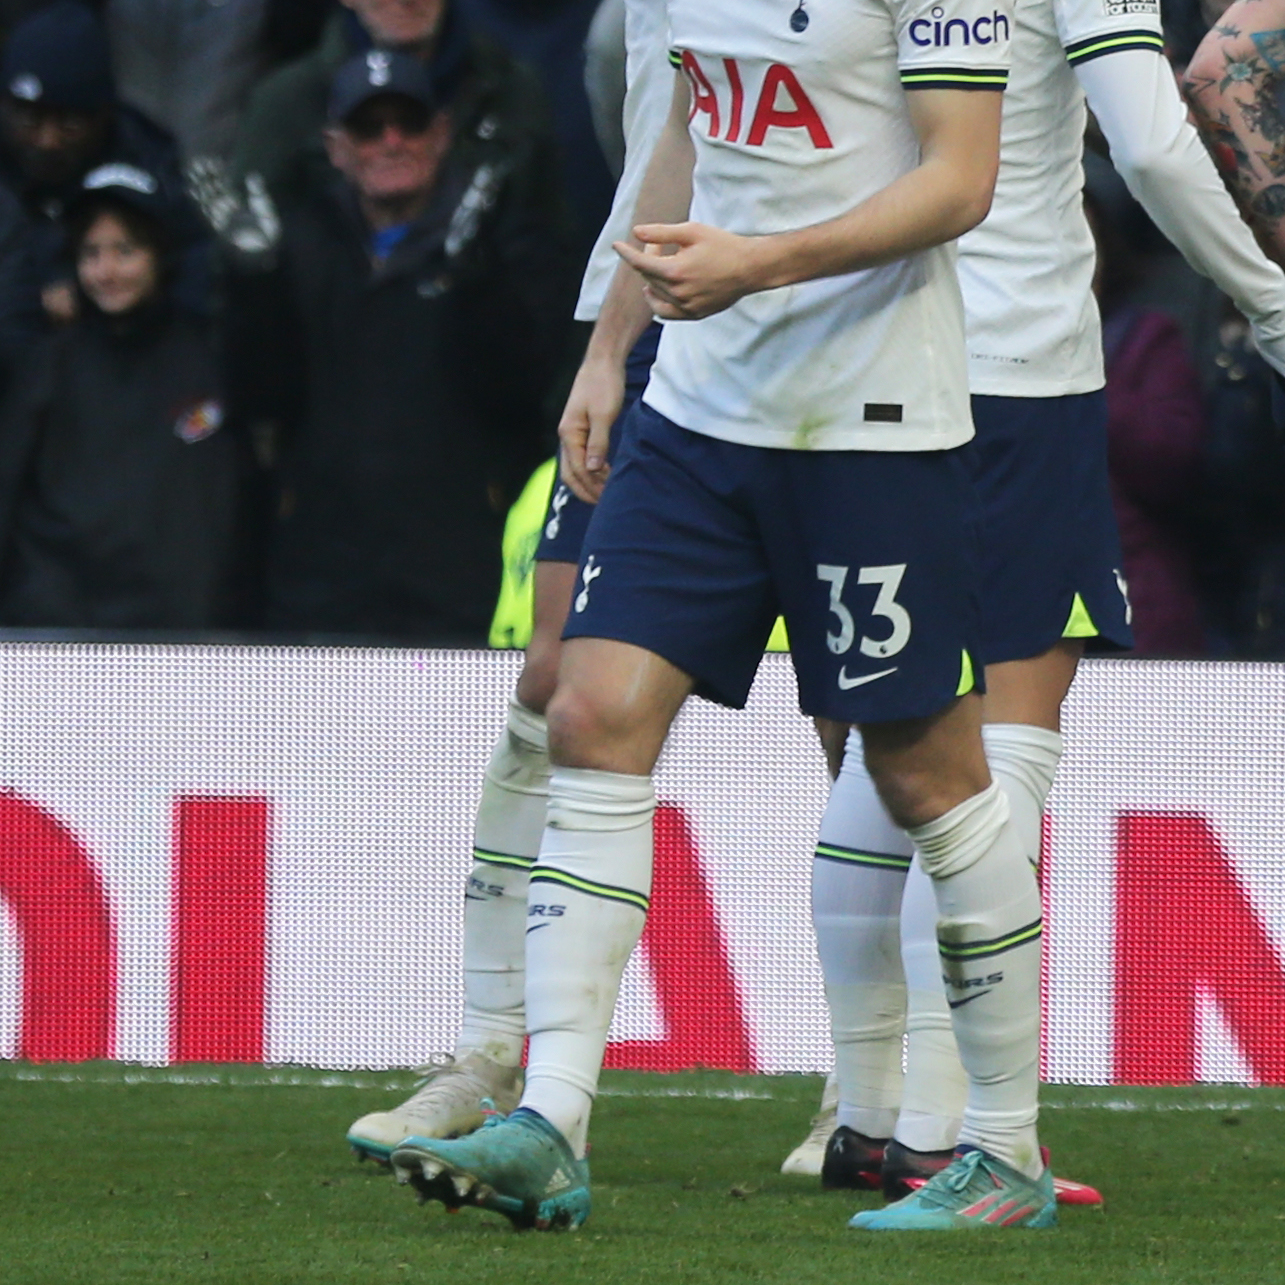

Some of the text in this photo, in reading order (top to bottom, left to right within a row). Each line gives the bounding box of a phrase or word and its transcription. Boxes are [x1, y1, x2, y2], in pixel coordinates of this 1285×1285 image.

[909, 6, 1010, 47] cinch
[681, 49, 834, 149] AIA
[816, 563, 911, 659] 33
